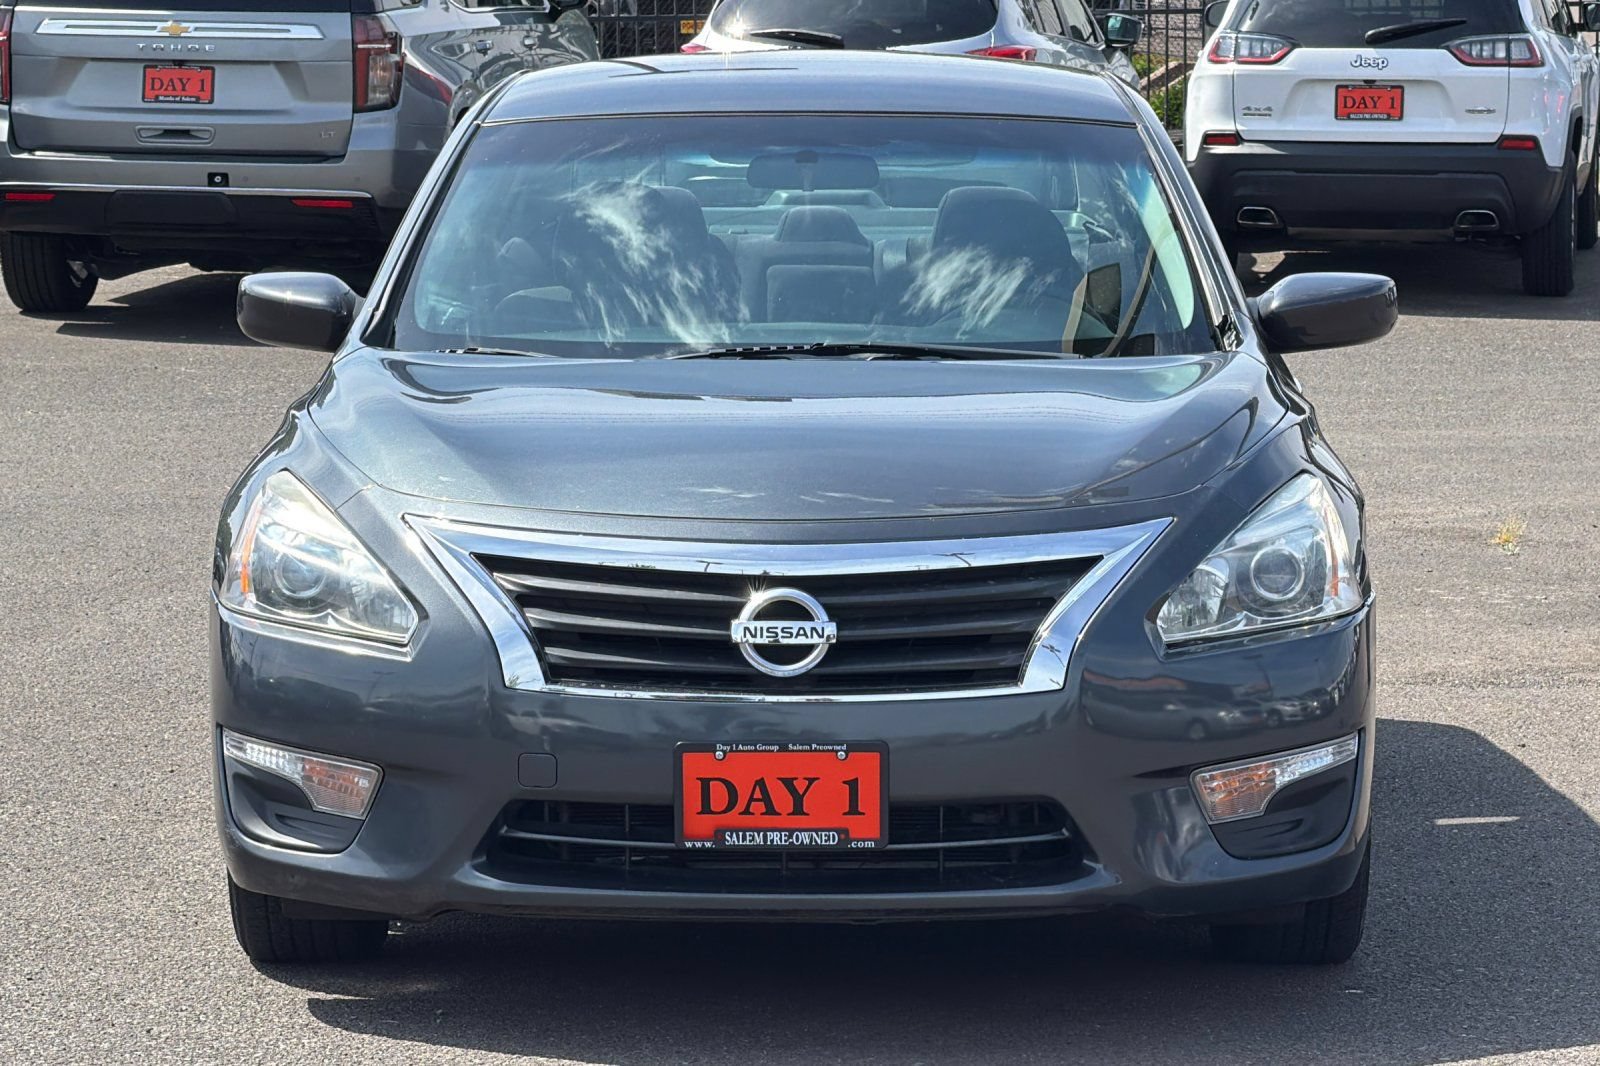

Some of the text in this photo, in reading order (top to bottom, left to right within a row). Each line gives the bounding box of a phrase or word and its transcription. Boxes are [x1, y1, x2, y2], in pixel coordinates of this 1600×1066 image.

[136, 43, 216, 52] TAHOE
[1350, 54, 1389, 70] Jeep
[150, 77, 206, 92] DAY 1
[1343, 95, 1397, 110] DAY 1
[743, 626, 825, 639] NISSAN
[716, 744, 731, 752] Day
[756, 744, 779, 752] Group
[695, 777, 866, 816] DAY 1
[725, 832, 765, 845] SALEM
[766, 832, 839, 845] PRE-OWNED
